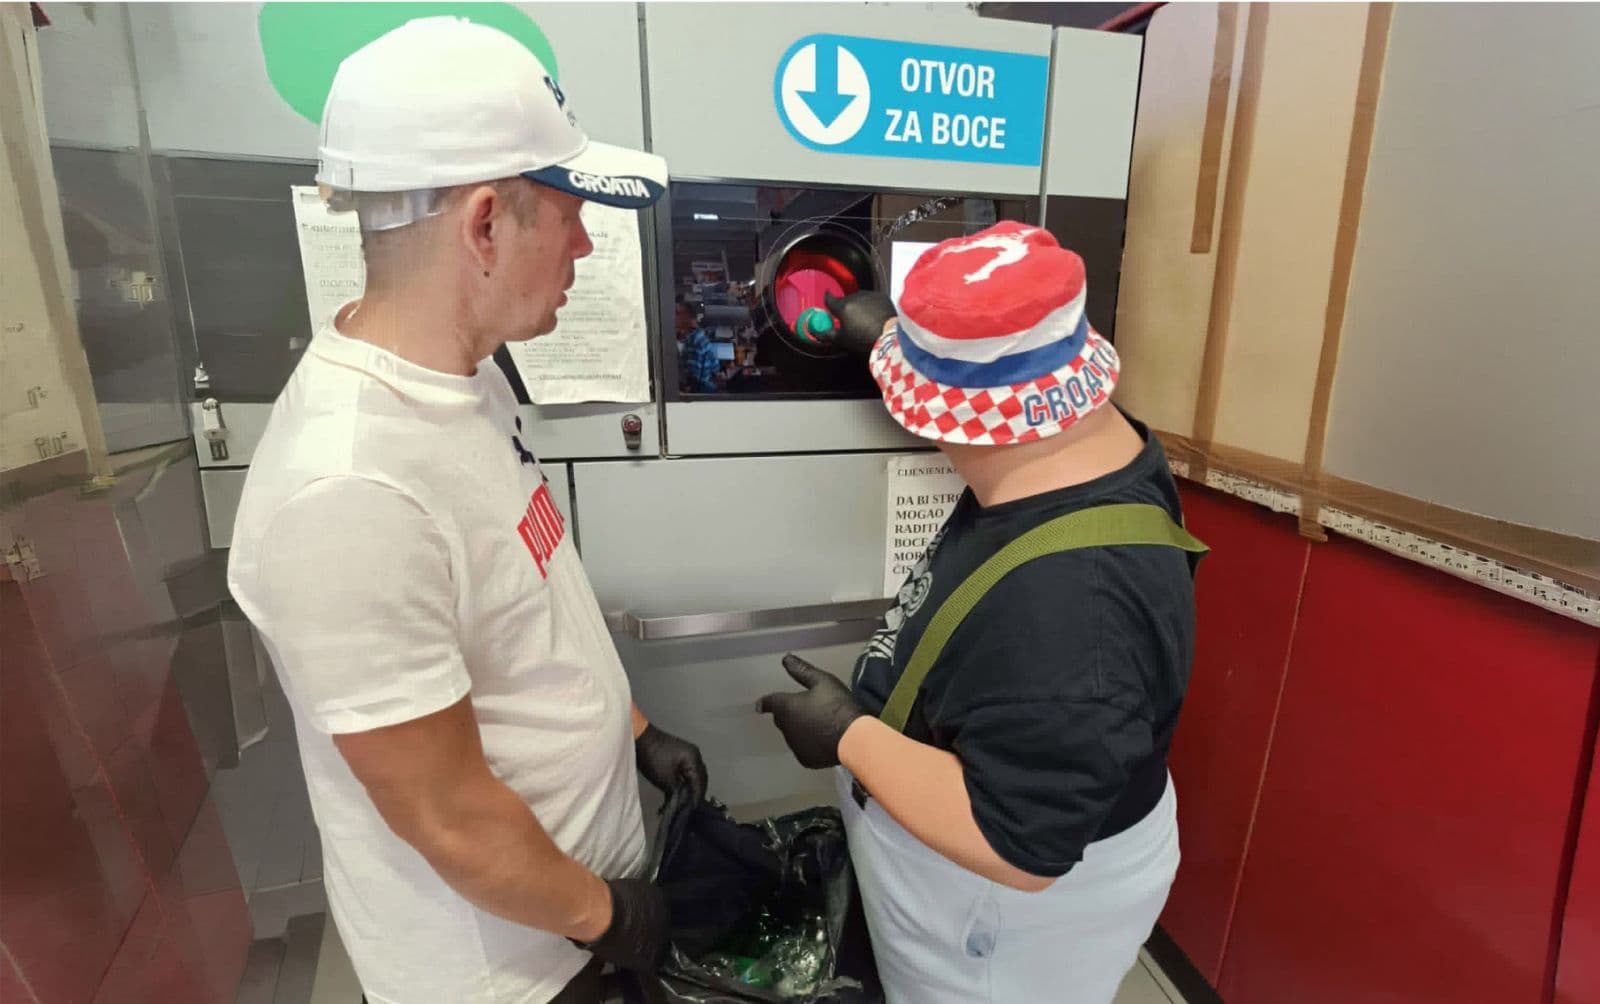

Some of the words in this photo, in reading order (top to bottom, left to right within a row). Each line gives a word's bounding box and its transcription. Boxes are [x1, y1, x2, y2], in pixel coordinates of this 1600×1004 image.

[901, 57, 995, 99] OTVOR
[884, 108, 923, 144] ZA
[932, 112, 1006, 150] BOCE
[568, 171, 651, 198] CROATIA
[896, 495, 914, 506] DA
[917, 494, 929, 505] BI
[896, 508, 944, 520] MOGAO
[517, 482, 566, 581] PUM
[895, 522, 938, 534] RADITI
[894, 537, 929, 548] BOCE
